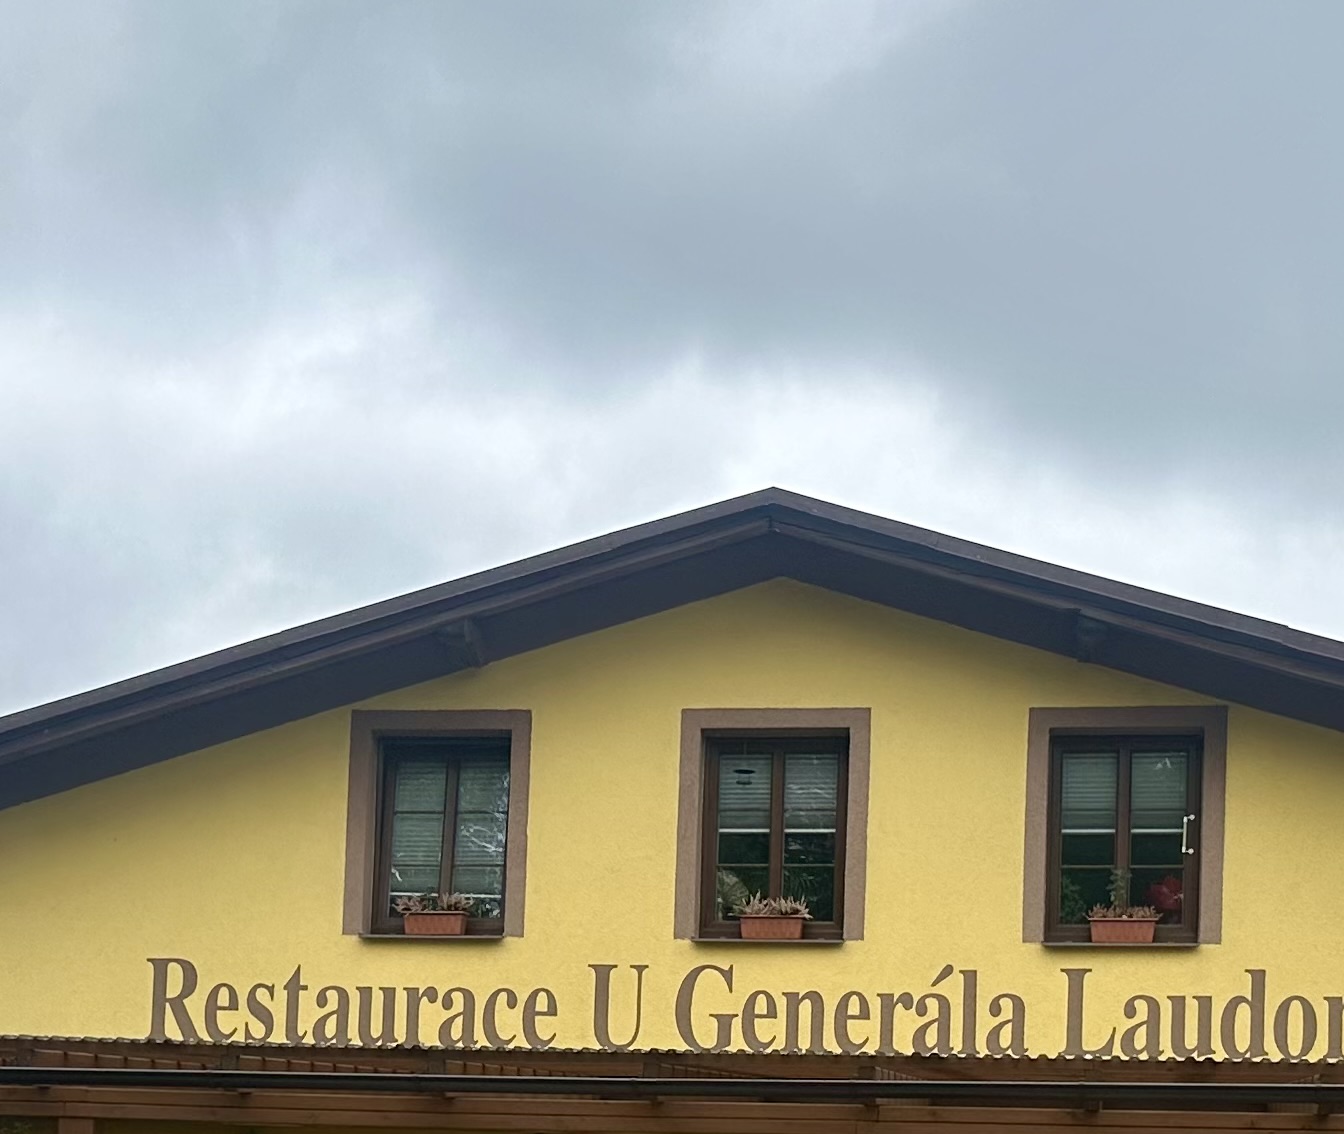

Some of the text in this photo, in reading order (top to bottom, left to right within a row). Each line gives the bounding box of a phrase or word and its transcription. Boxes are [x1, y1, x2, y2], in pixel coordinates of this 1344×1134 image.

[146, 957, 558, 1048] Restaurace
[587, 963, 649, 1050] U
[674, 963, 1029, 1056] Generála
